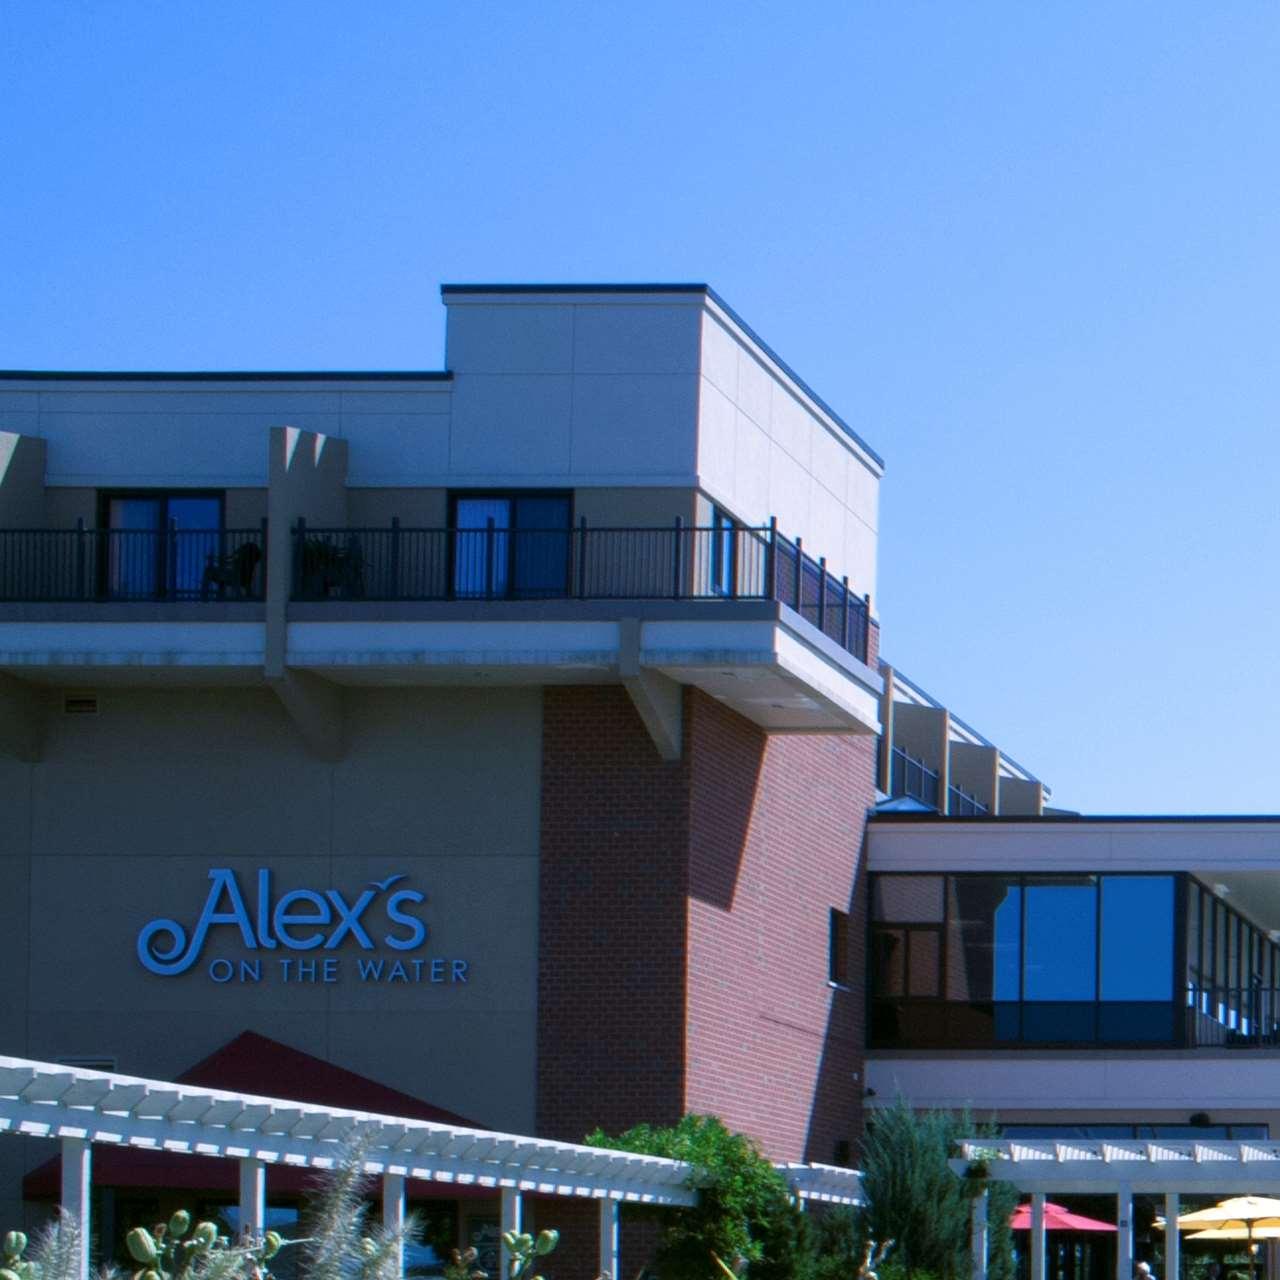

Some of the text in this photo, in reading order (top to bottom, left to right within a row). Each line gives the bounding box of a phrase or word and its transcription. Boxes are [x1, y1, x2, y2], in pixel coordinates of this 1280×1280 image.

[136, 867, 427, 976] Alex's
[208, 958, 471, 983] ON THE WATER
